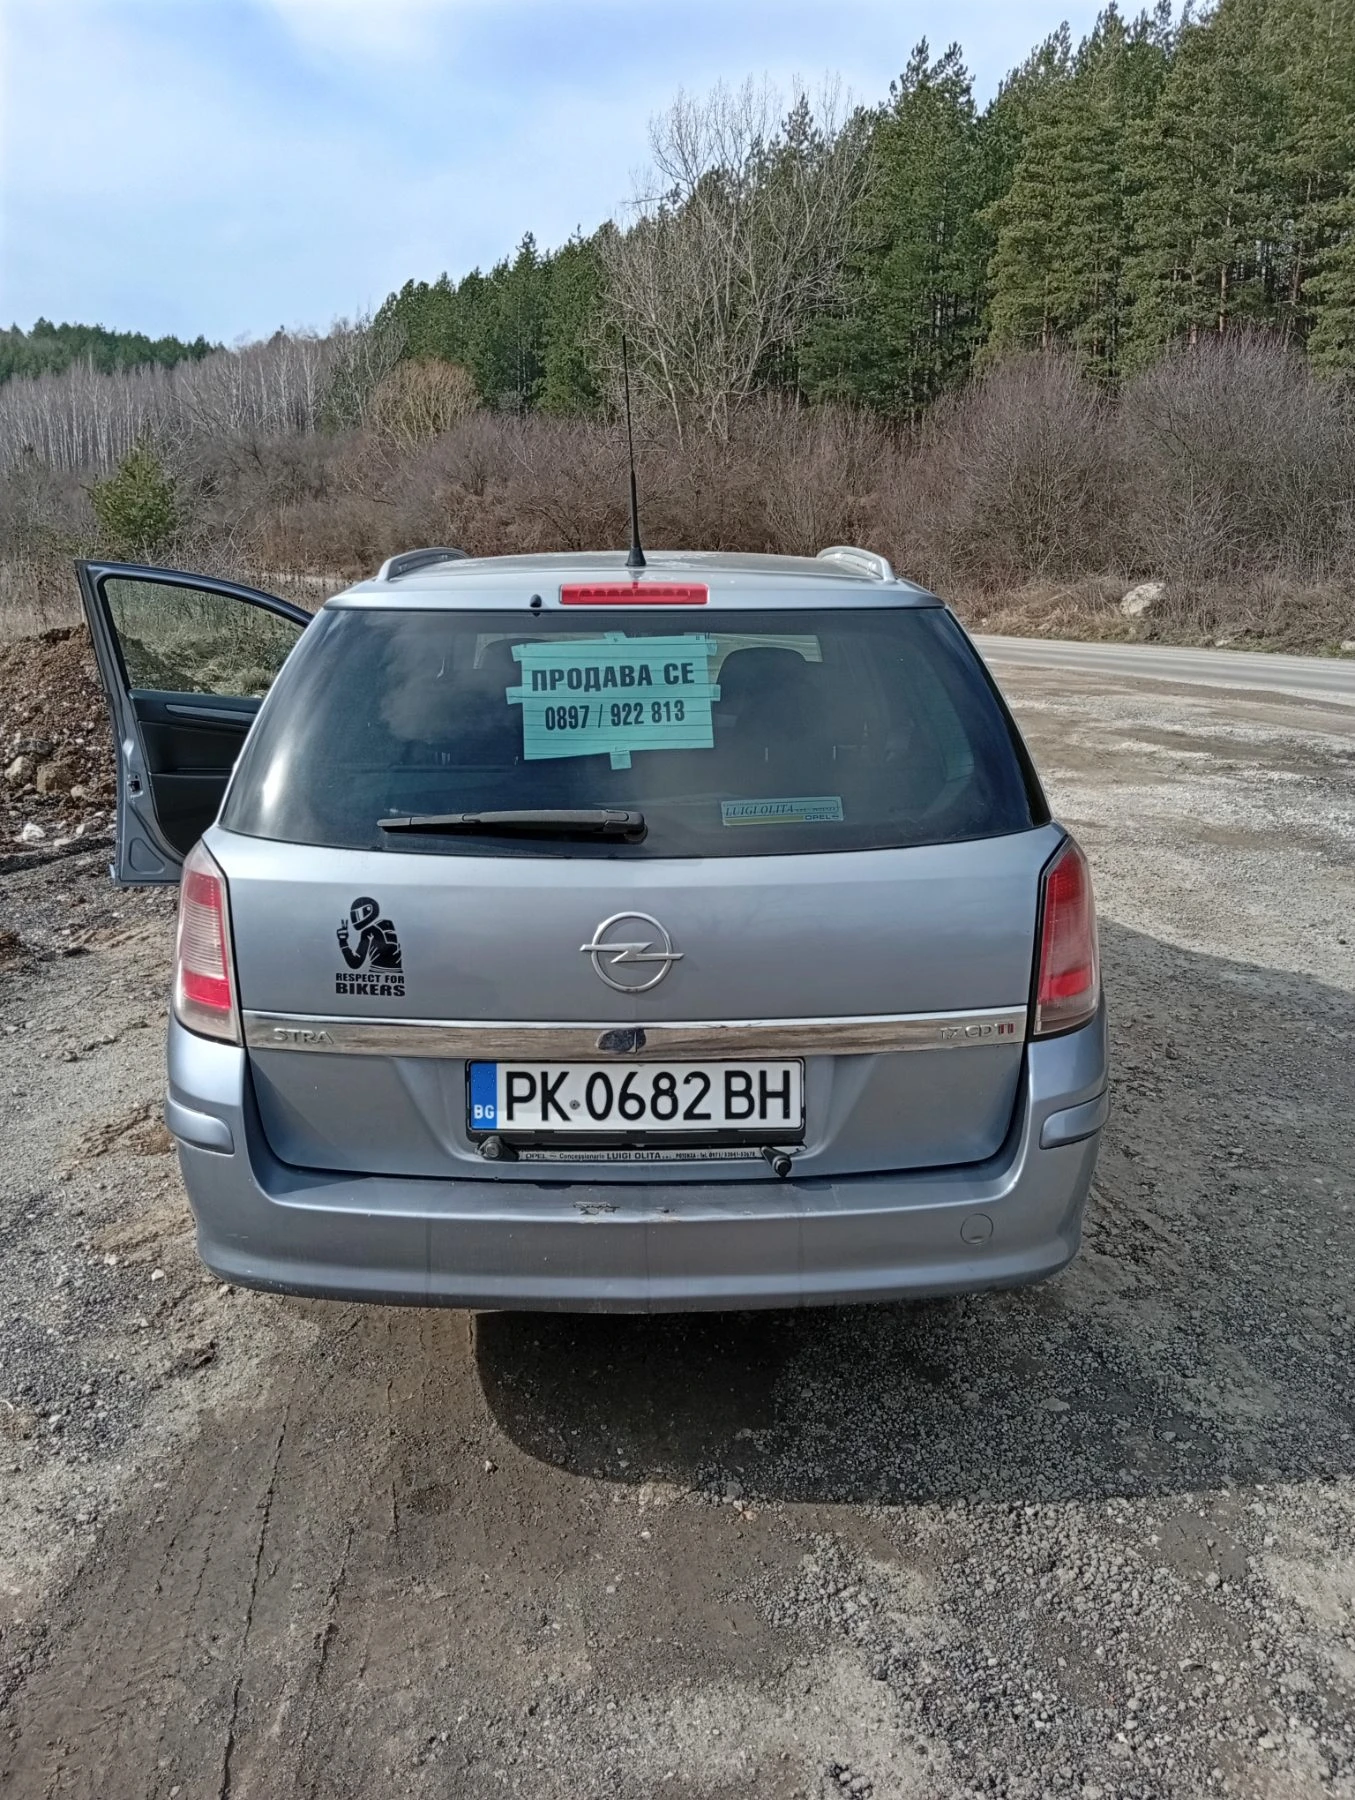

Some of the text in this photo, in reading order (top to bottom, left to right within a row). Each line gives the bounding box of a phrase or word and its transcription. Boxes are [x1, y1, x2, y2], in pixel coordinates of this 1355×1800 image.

[531, 662, 695, 692] ПРОДАВА СЕ
[545, 705, 590, 731] 0897
[610, 702, 644, 727] 922
[651, 700, 685, 723] 813
[336, 973, 405, 984] RESPECT FOR
[336, 982, 405, 997] BIKERS
[272, 1027, 335, 1045] STRA
[506, 1070, 791, 1121] PK 0682 BH
[473, 1104, 495, 1119] BG
[606, 1152, 631, 1160] LUIGI
[634, 1151, 661, 1160] OLITA
